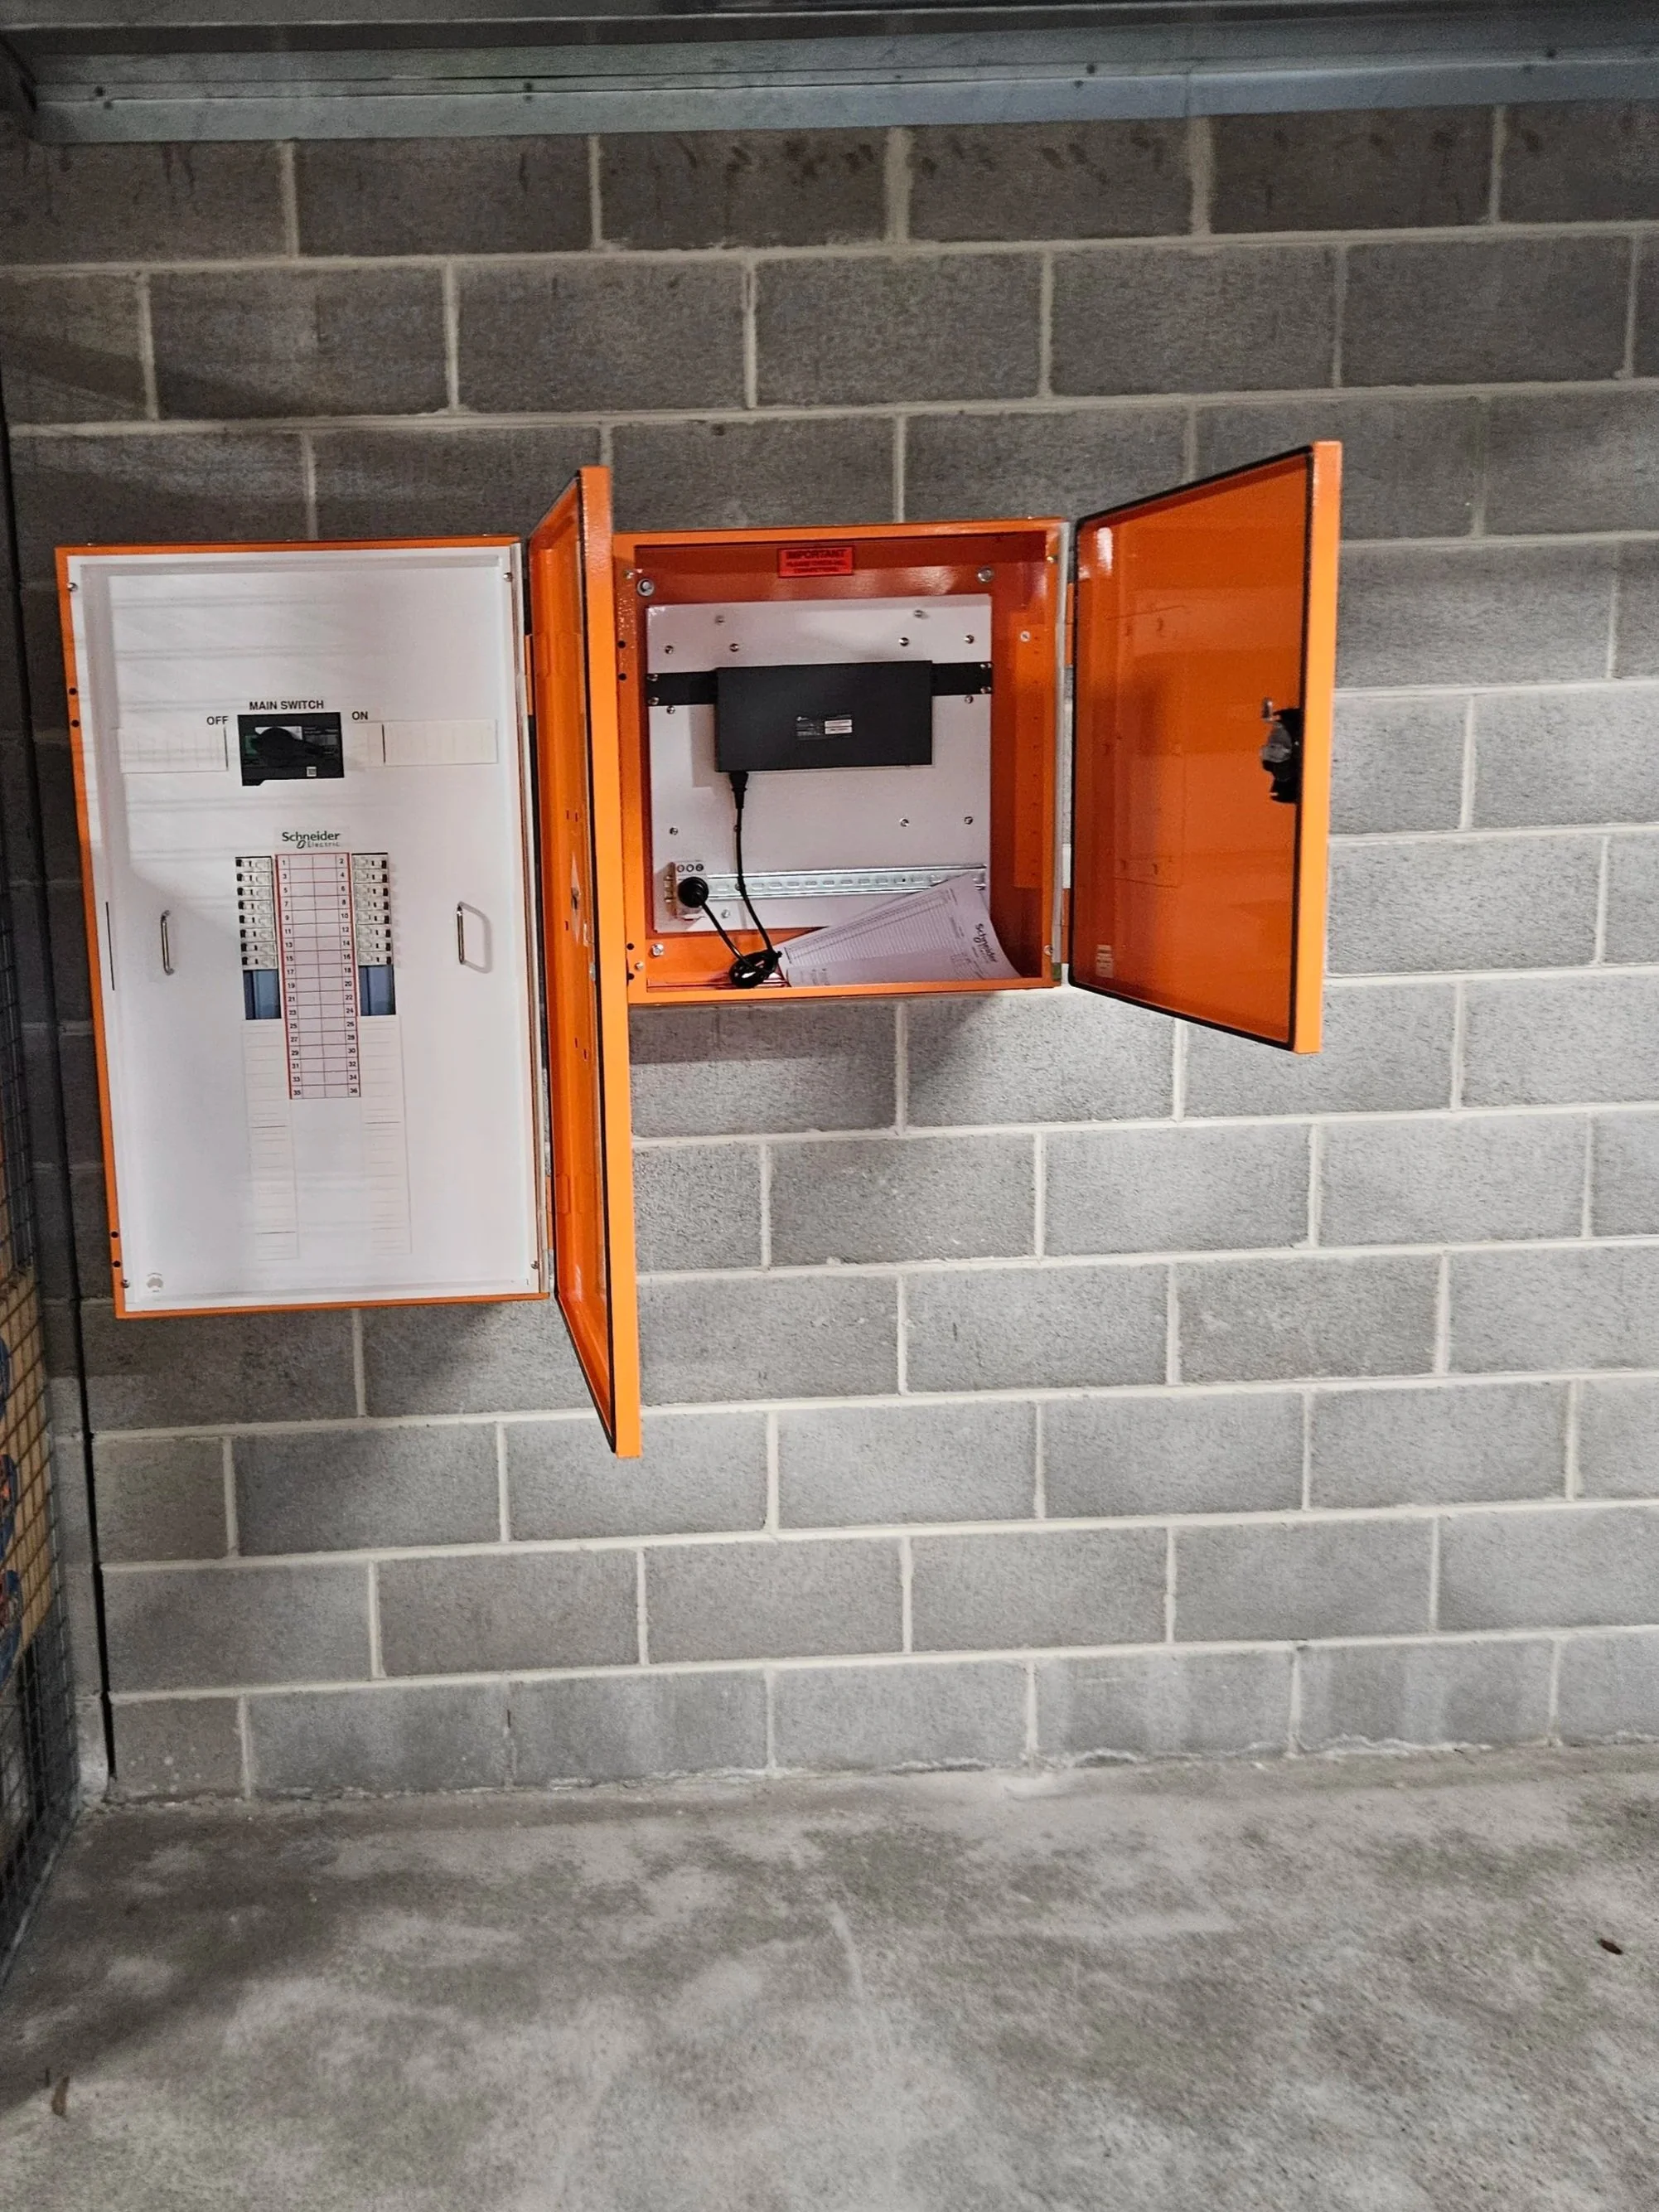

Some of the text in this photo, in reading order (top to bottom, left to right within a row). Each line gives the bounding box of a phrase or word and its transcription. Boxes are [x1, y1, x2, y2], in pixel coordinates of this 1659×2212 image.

[249, 700, 324, 710] MAIN SWITCH
[206, 716, 229, 725] OFF
[351, 711, 369, 720] ON
[282, 830, 341, 842] Schneider
[975, 923, 998, 962] Schneider
